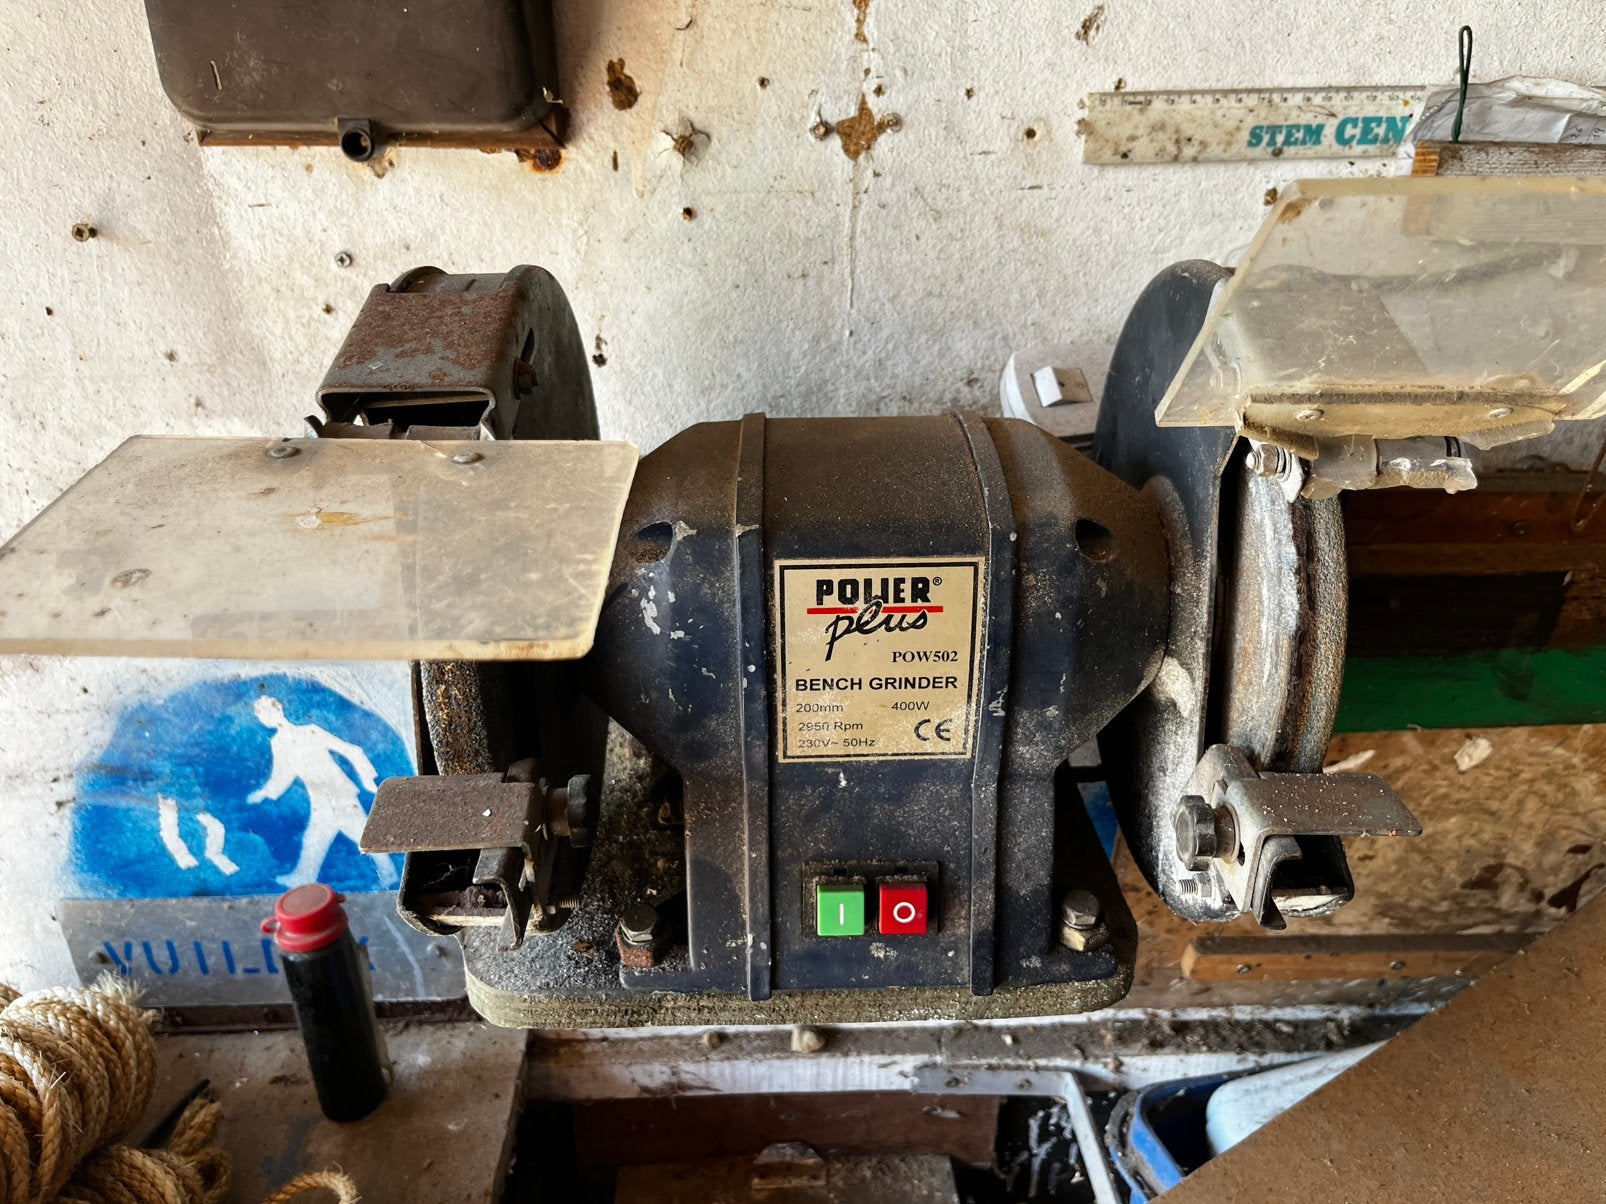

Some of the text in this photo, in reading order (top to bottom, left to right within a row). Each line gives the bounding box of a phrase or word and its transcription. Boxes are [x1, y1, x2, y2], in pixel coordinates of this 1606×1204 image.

[1247, 123, 1325, 148] STEM
[824, 599, 928, 662] plus
[892, 650, 958, 663] POW502
[795, 676, 958, 692] BENCH GRINDER
[796, 701, 930, 713] 200mm 400W
[798, 721, 864, 732] 2950 Rpm
[843, 738, 876, 748] 50Hz
